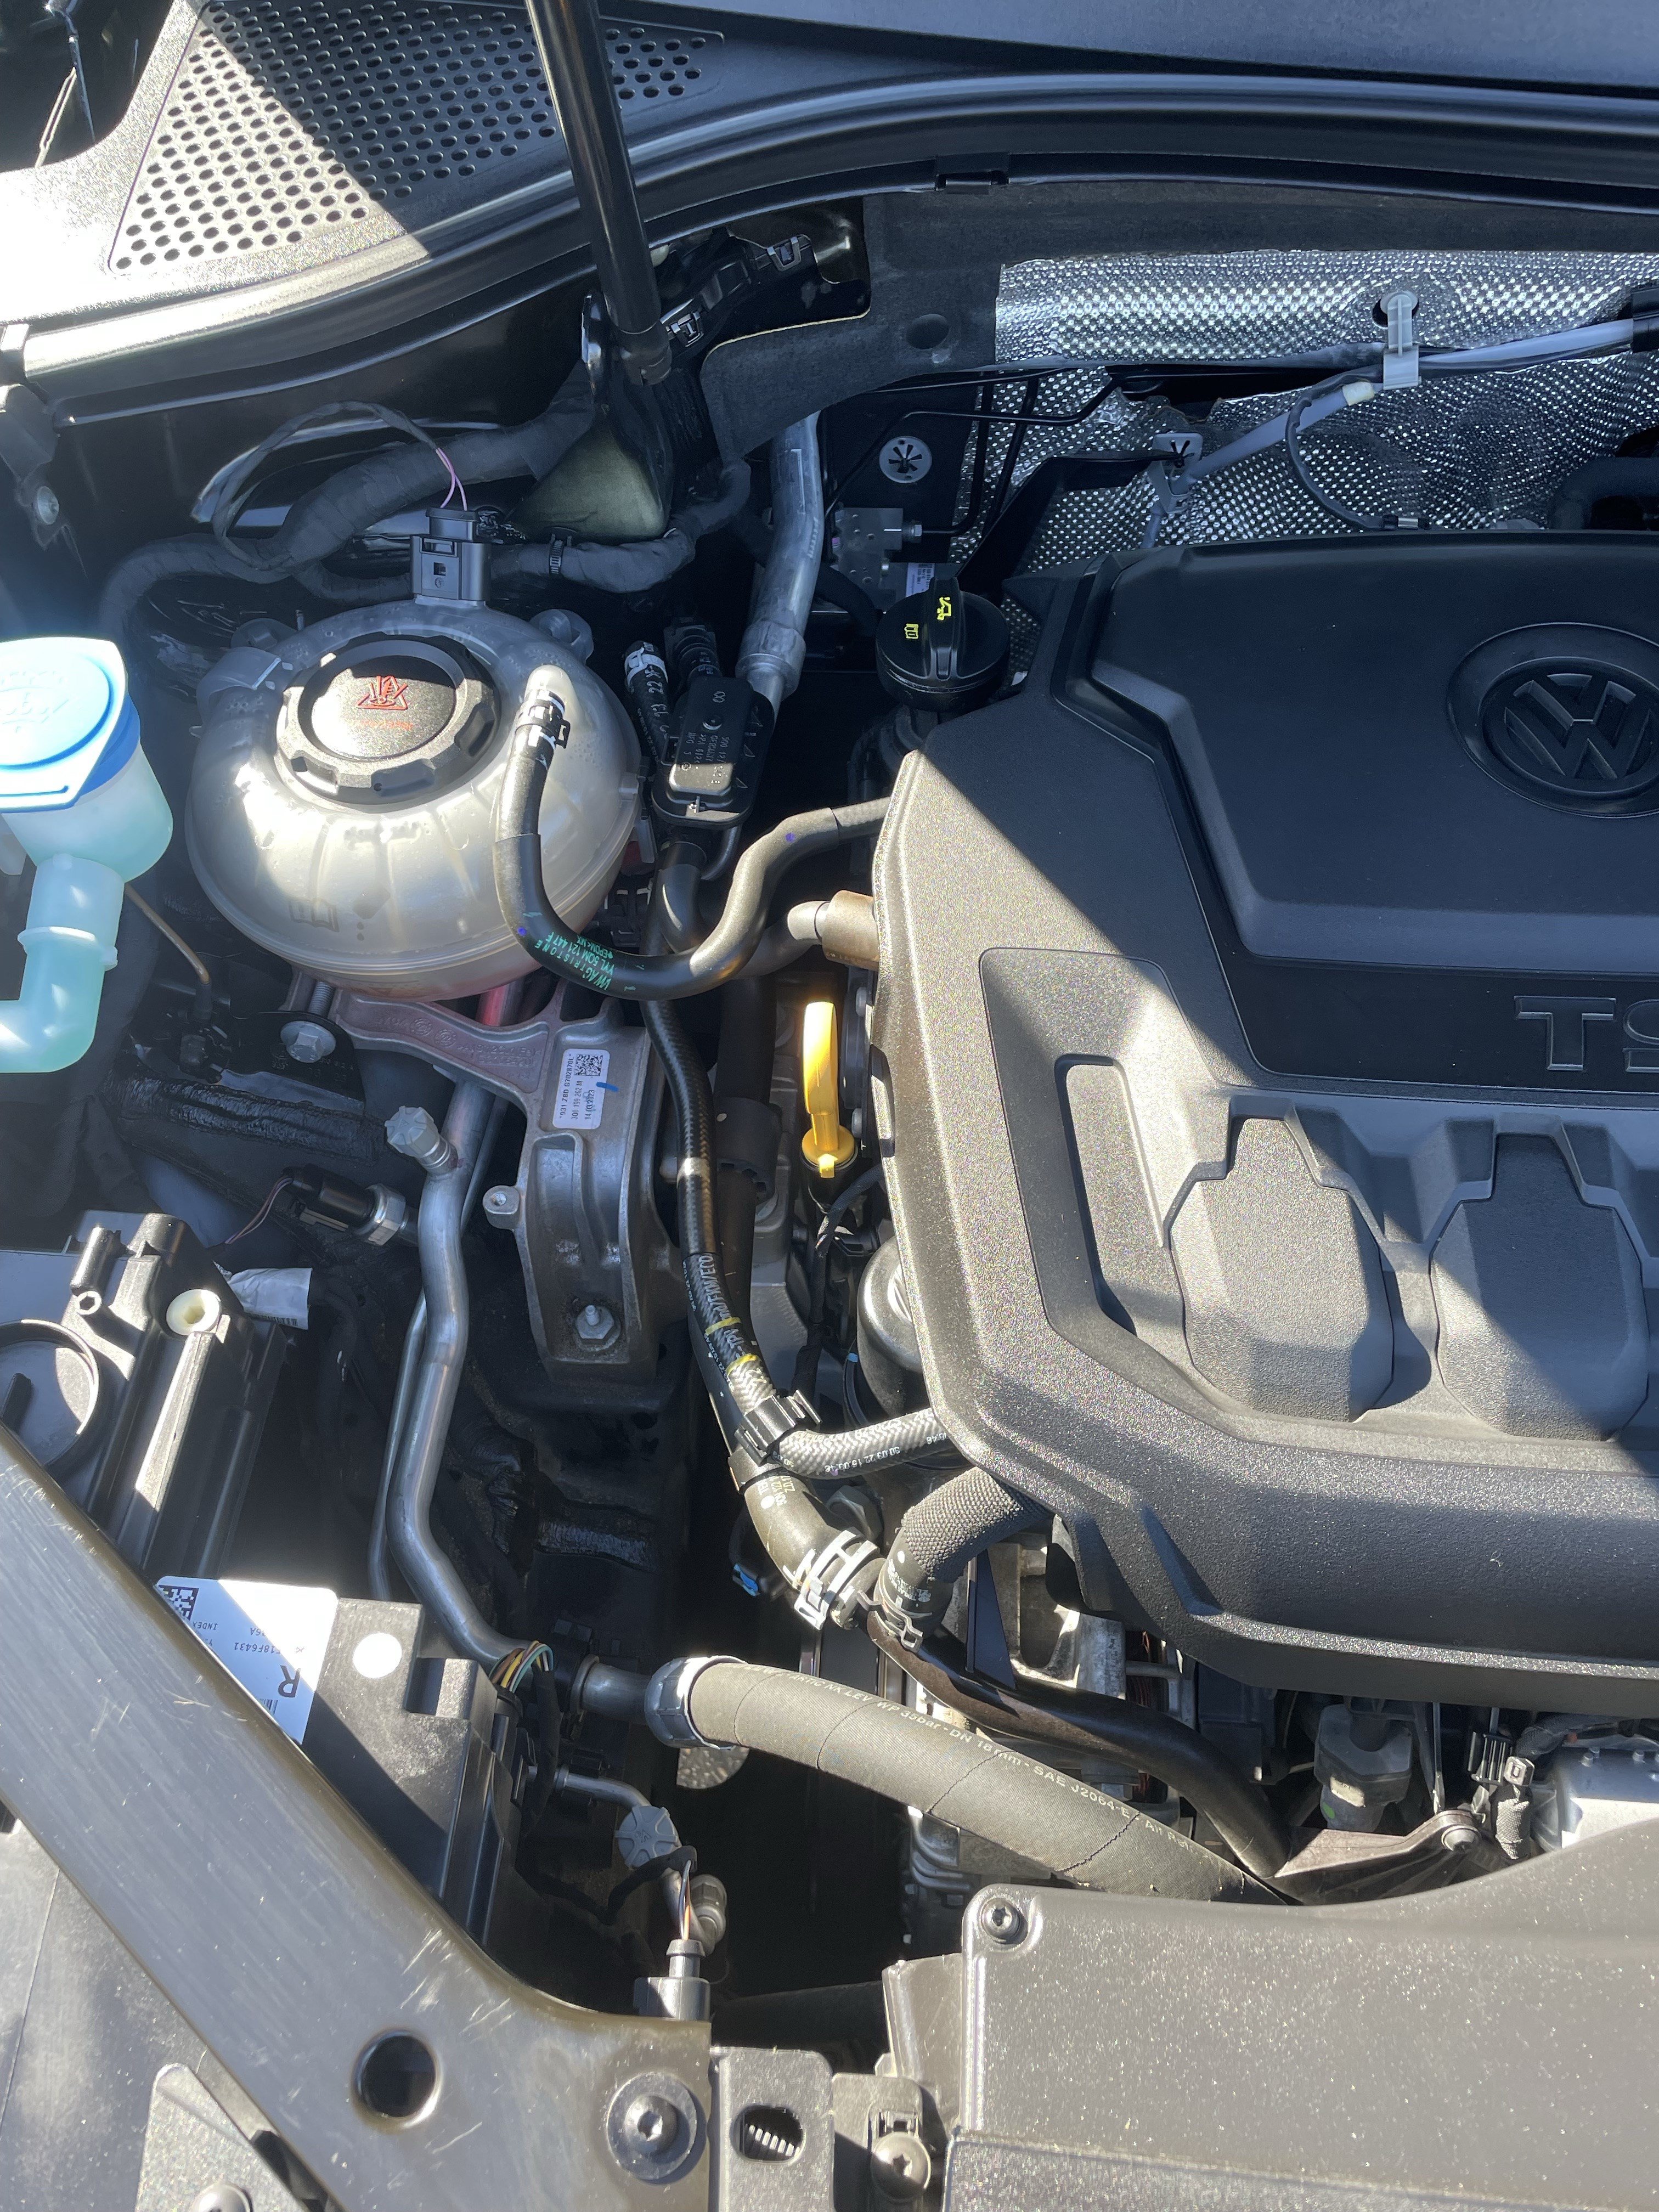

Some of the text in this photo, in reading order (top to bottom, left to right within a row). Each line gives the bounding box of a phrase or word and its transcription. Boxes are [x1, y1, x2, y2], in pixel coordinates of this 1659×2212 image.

[192, 1622, 218, 1630] INDEX
[278, 1664, 301, 1698] R
[900, 1709, 941, 1729] 35bar
[949, 1729, 972, 1743] DN
[1033, 1765, 1066, 1788] SAE
